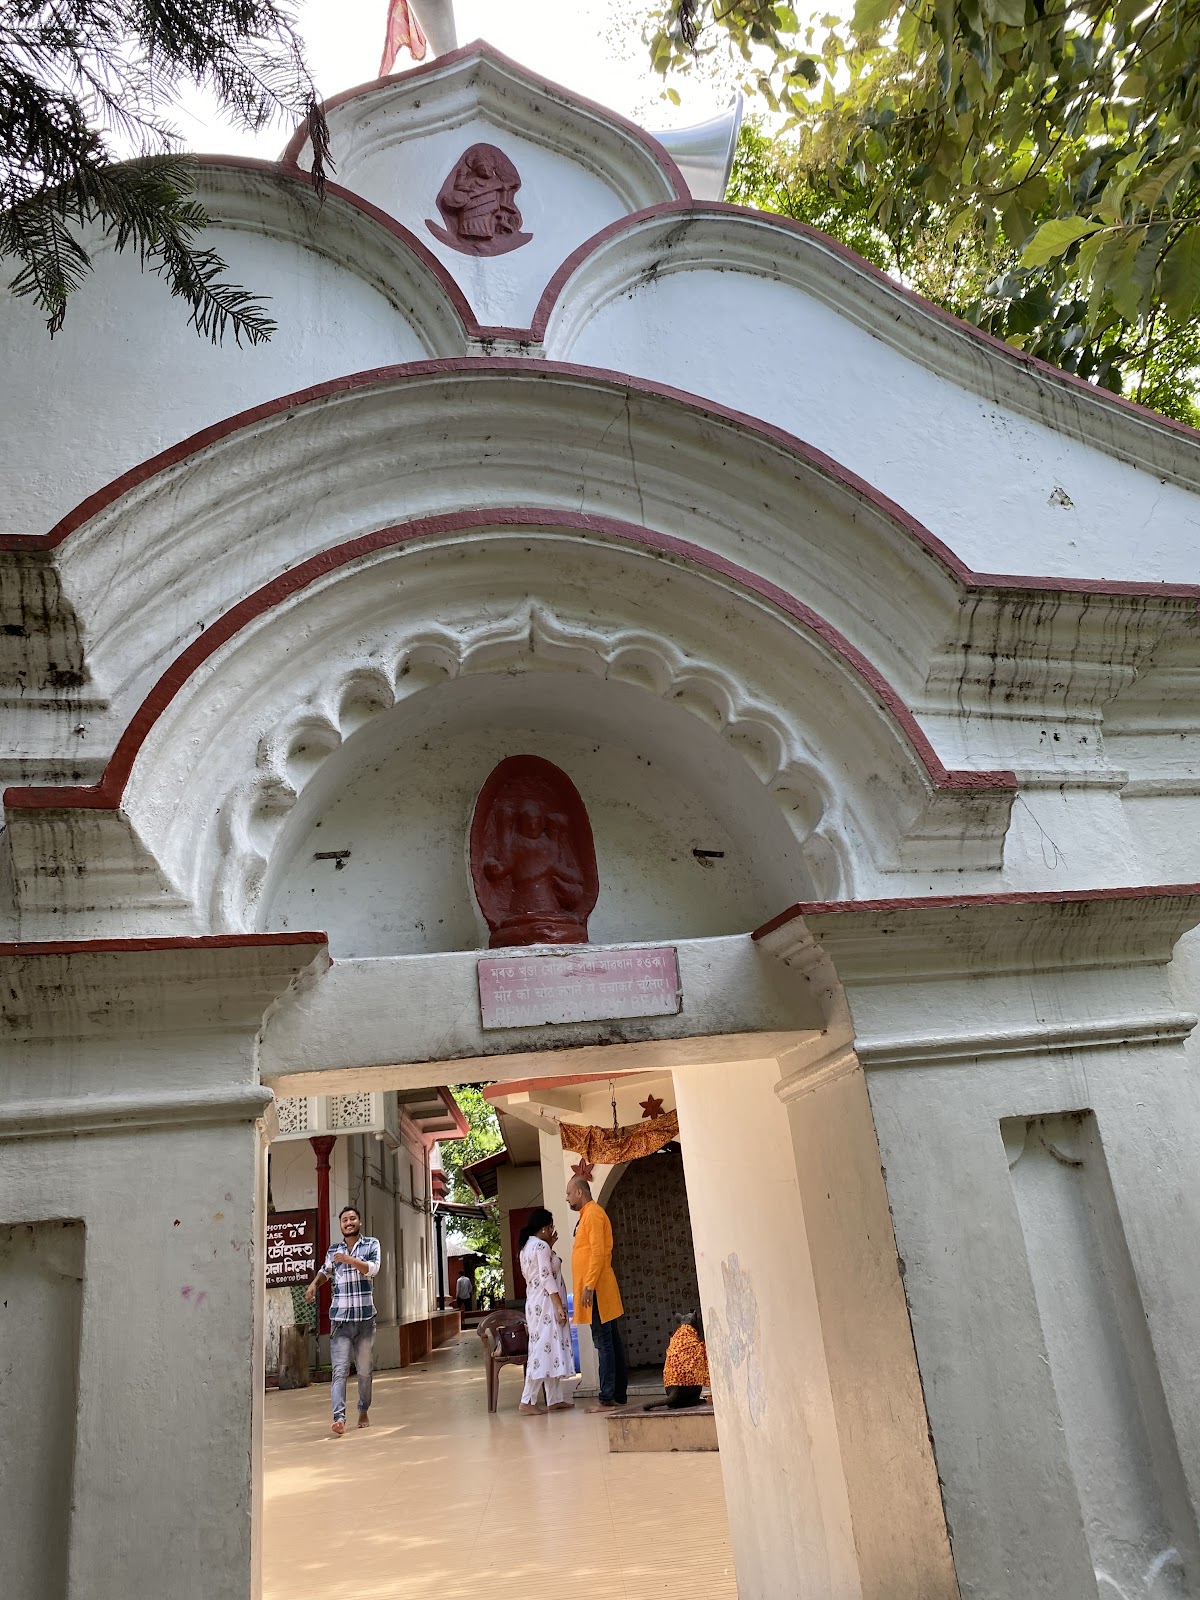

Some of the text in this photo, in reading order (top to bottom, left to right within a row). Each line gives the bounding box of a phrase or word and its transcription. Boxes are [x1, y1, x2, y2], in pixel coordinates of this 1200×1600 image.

[516, 983, 531, 1000] को
[631, 993, 674, 1011] BEAM
[284, 1257, 316, 1273] নিষেধ
